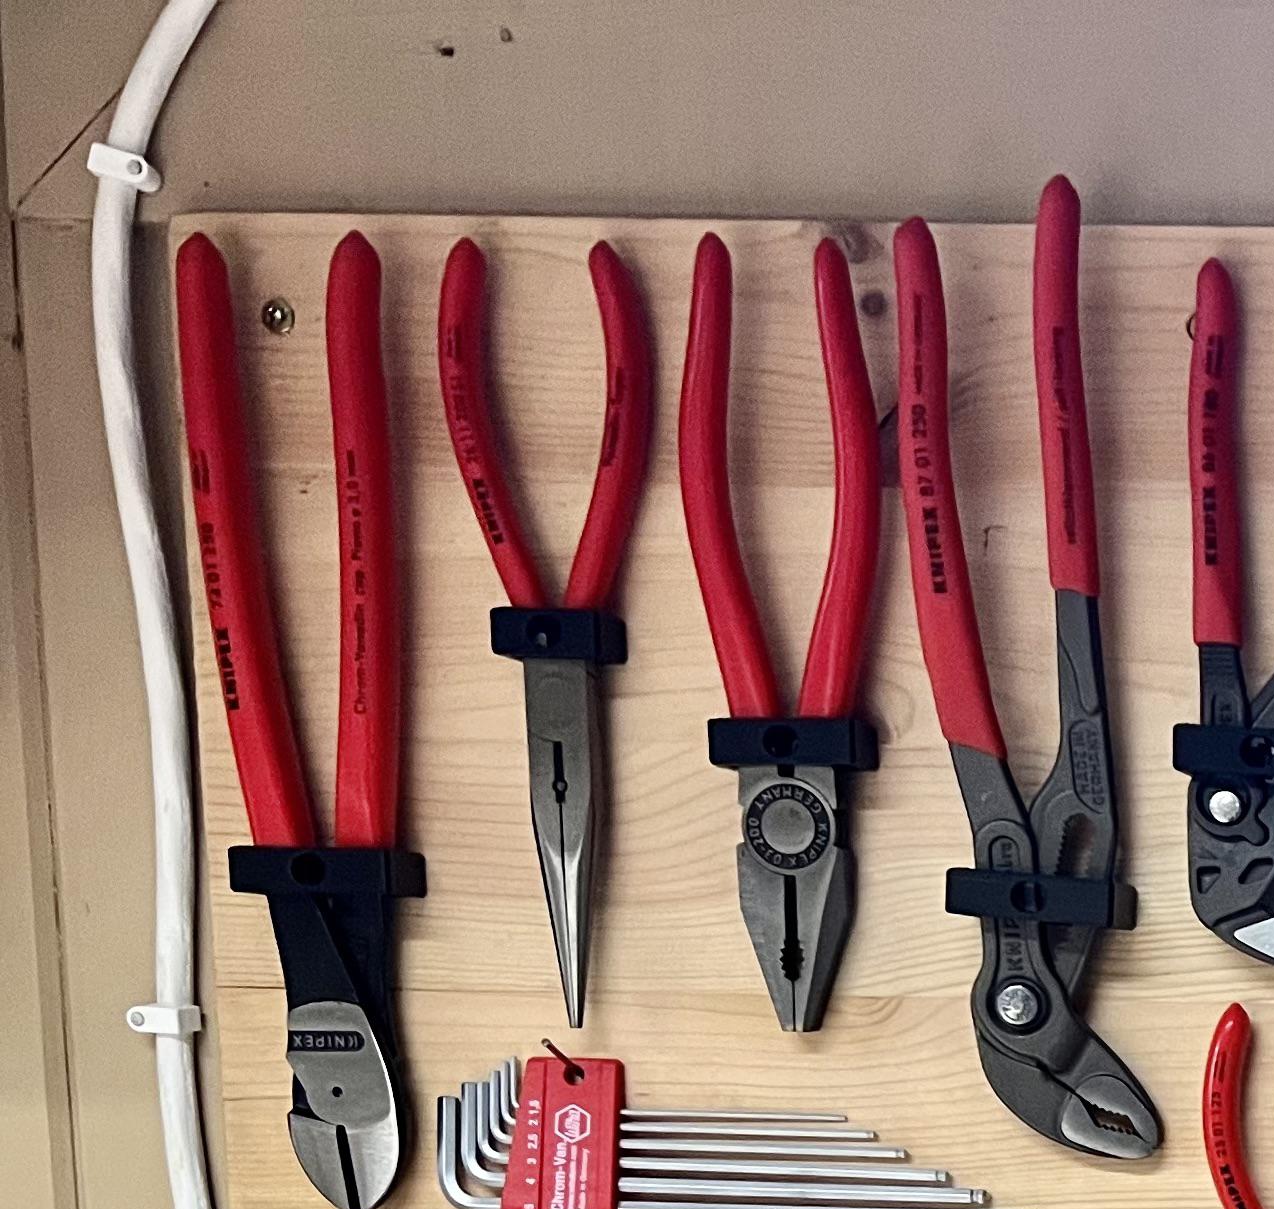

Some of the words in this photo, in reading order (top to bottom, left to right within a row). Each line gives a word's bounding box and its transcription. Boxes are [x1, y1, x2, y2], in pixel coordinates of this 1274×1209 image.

[911, 403, 927, 439] 250
[914, 448, 931, 469] 01
[919, 476, 935, 497] 87
[1202, 485, 1217, 566] KNIPEX
[922, 506, 948, 594] KNIPEX
[214, 627, 240, 711] KNIPEX
[754, 785, 822, 815] GERMANY
[790, 822, 829, 867] KNIPEX
[292, 1033, 360, 1049] KNIPEX
[1211, 1121, 1226, 1137] 01
[526, 1157, 538, 1165] 3
[525, 1177, 537, 1185] 4
